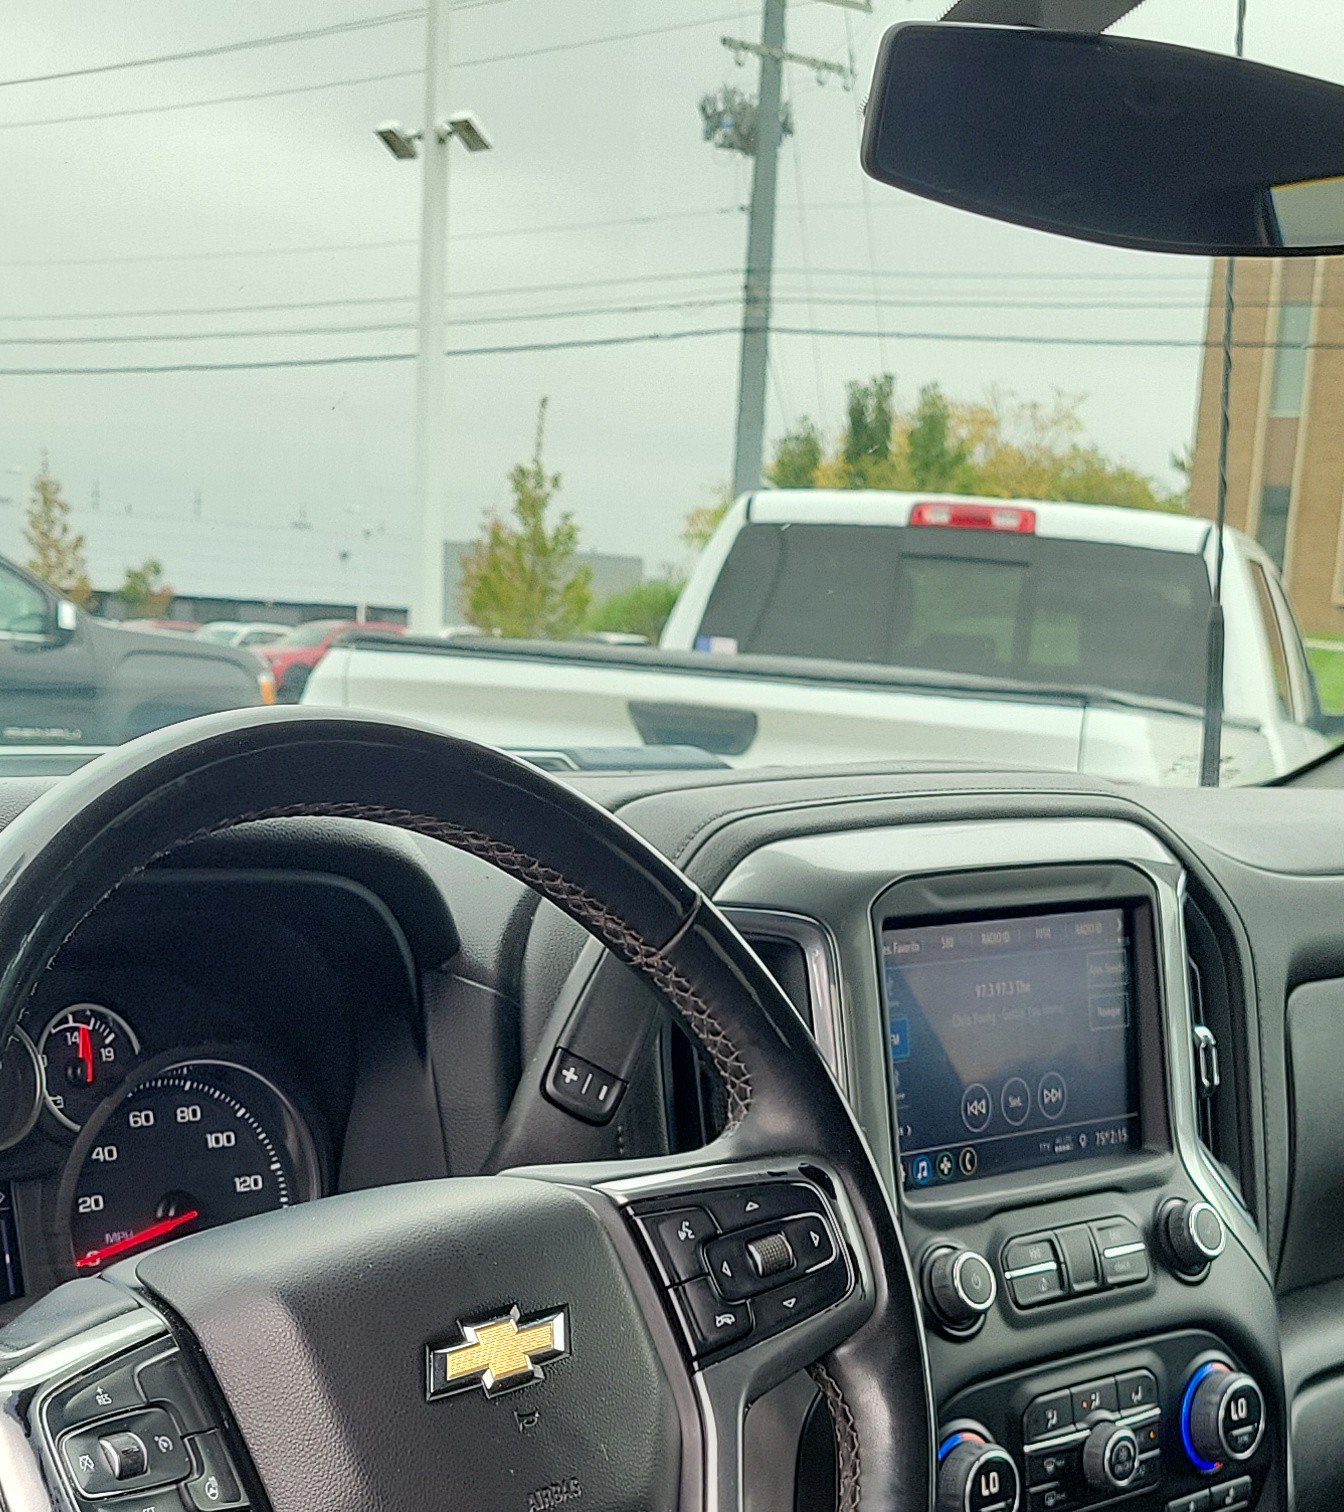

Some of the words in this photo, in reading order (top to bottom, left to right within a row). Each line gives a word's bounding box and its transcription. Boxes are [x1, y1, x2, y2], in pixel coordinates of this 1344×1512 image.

[66, 1031, 80, 1046] 14
[100, 1047, 115, 1061] 19
[129, 1111, 154, 1128] 60
[176, 1105, 201, 1122] 80
[206, 1131, 236, 1148] 100
[91, 1146, 118, 1162] 40
[234, 1175, 262, 1192] 120
[78, 1195, 104, 1213] 20
[96, 1393, 112, 1406] RES
[1231, 1397, 1246, 1421] LO
[981, 1471, 999, 1496] LO
